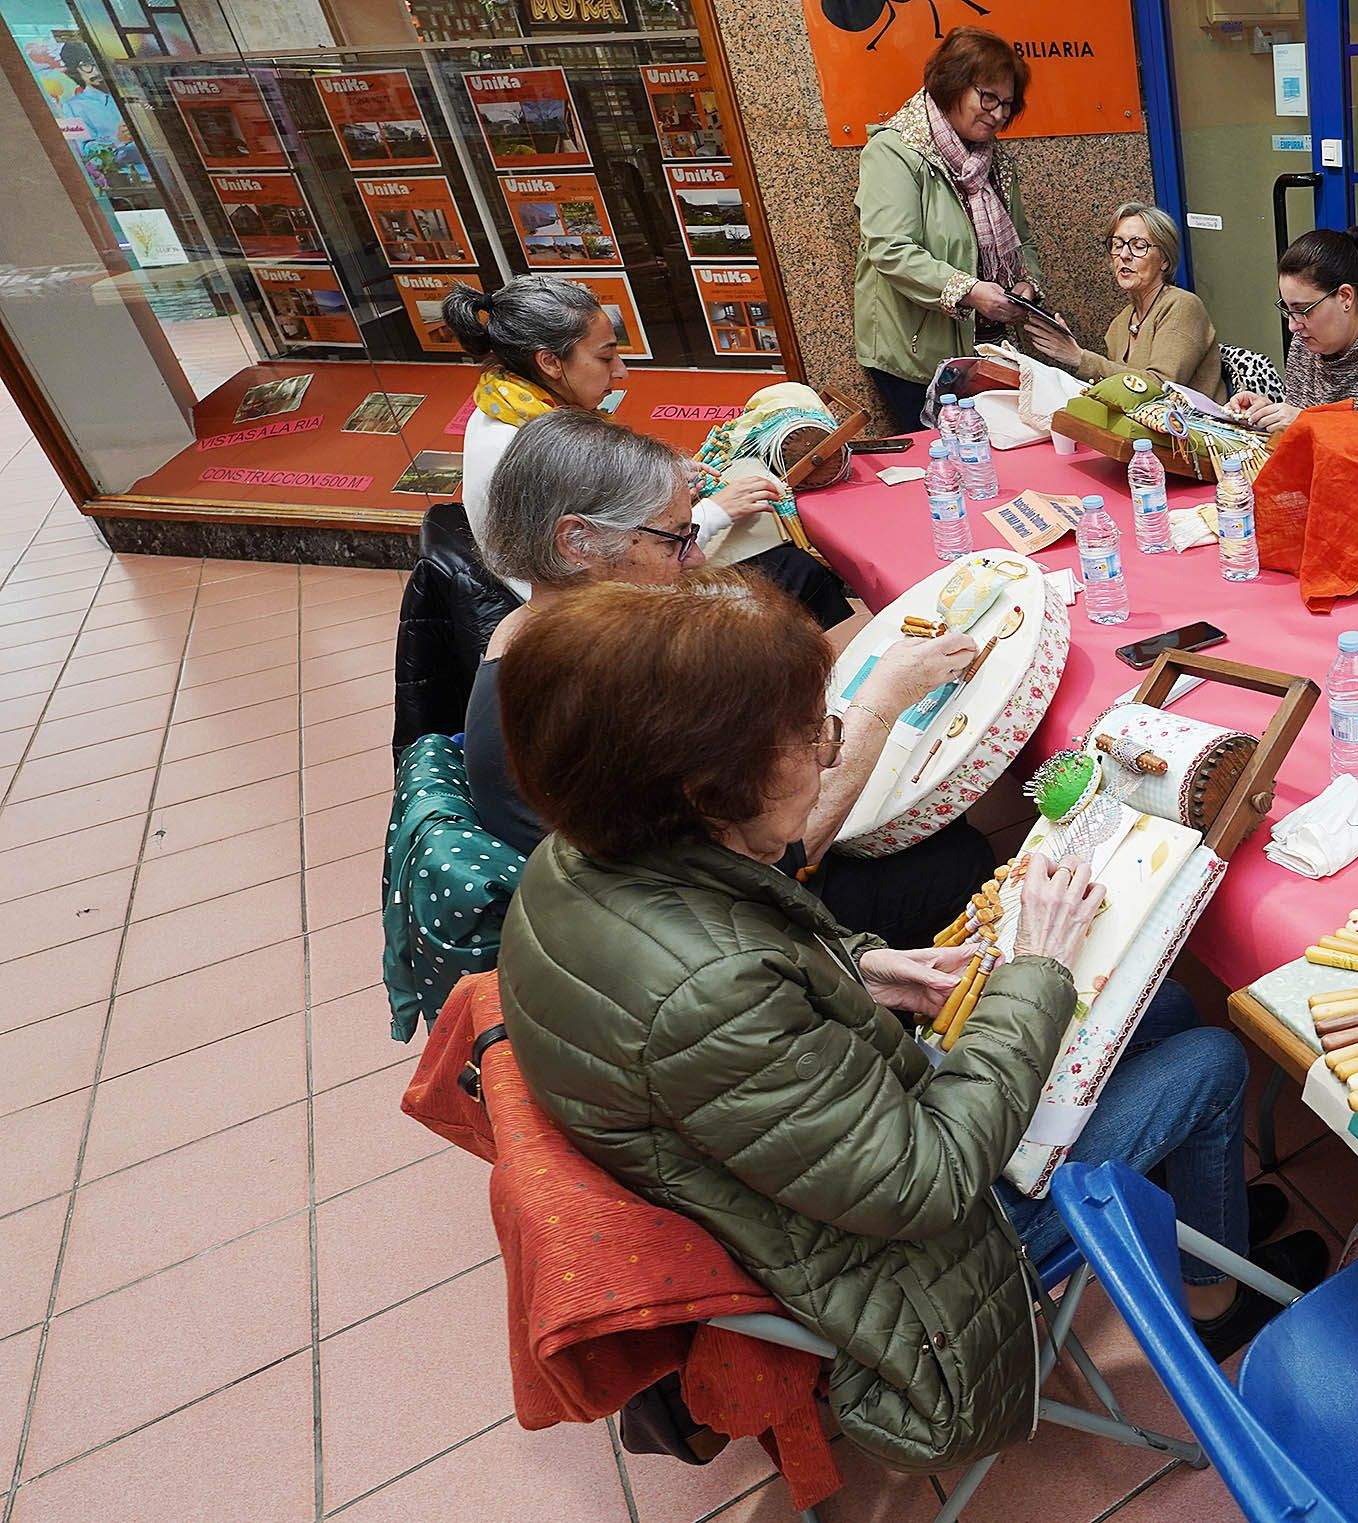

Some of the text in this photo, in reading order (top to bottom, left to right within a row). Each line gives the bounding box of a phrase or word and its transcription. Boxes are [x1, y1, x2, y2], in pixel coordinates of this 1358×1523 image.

[1014, 41, 1095, 58] BILIARIA
[470, 75, 522, 91] UniKa
[646, 69, 700, 84] UniKa
[320, 78, 370, 93] UniKa
[671, 168, 726, 182] UniKa
[217, 178, 263, 191] UniKa
[363, 182, 410, 196] UniKa
[504, 178, 556, 193] UniKa
[399, 275, 444, 289] UniKa
[699, 269, 752, 283] UniKa
[652, 405, 744, 419] ZONA PLAY
[200, 428, 254, 449] VISTAS
[269, 422, 291, 434] LA
[293, 417, 321, 430] RIA
[202, 468, 318, 487] CONSTRUCCION
[319, 475, 349, 488] 500
